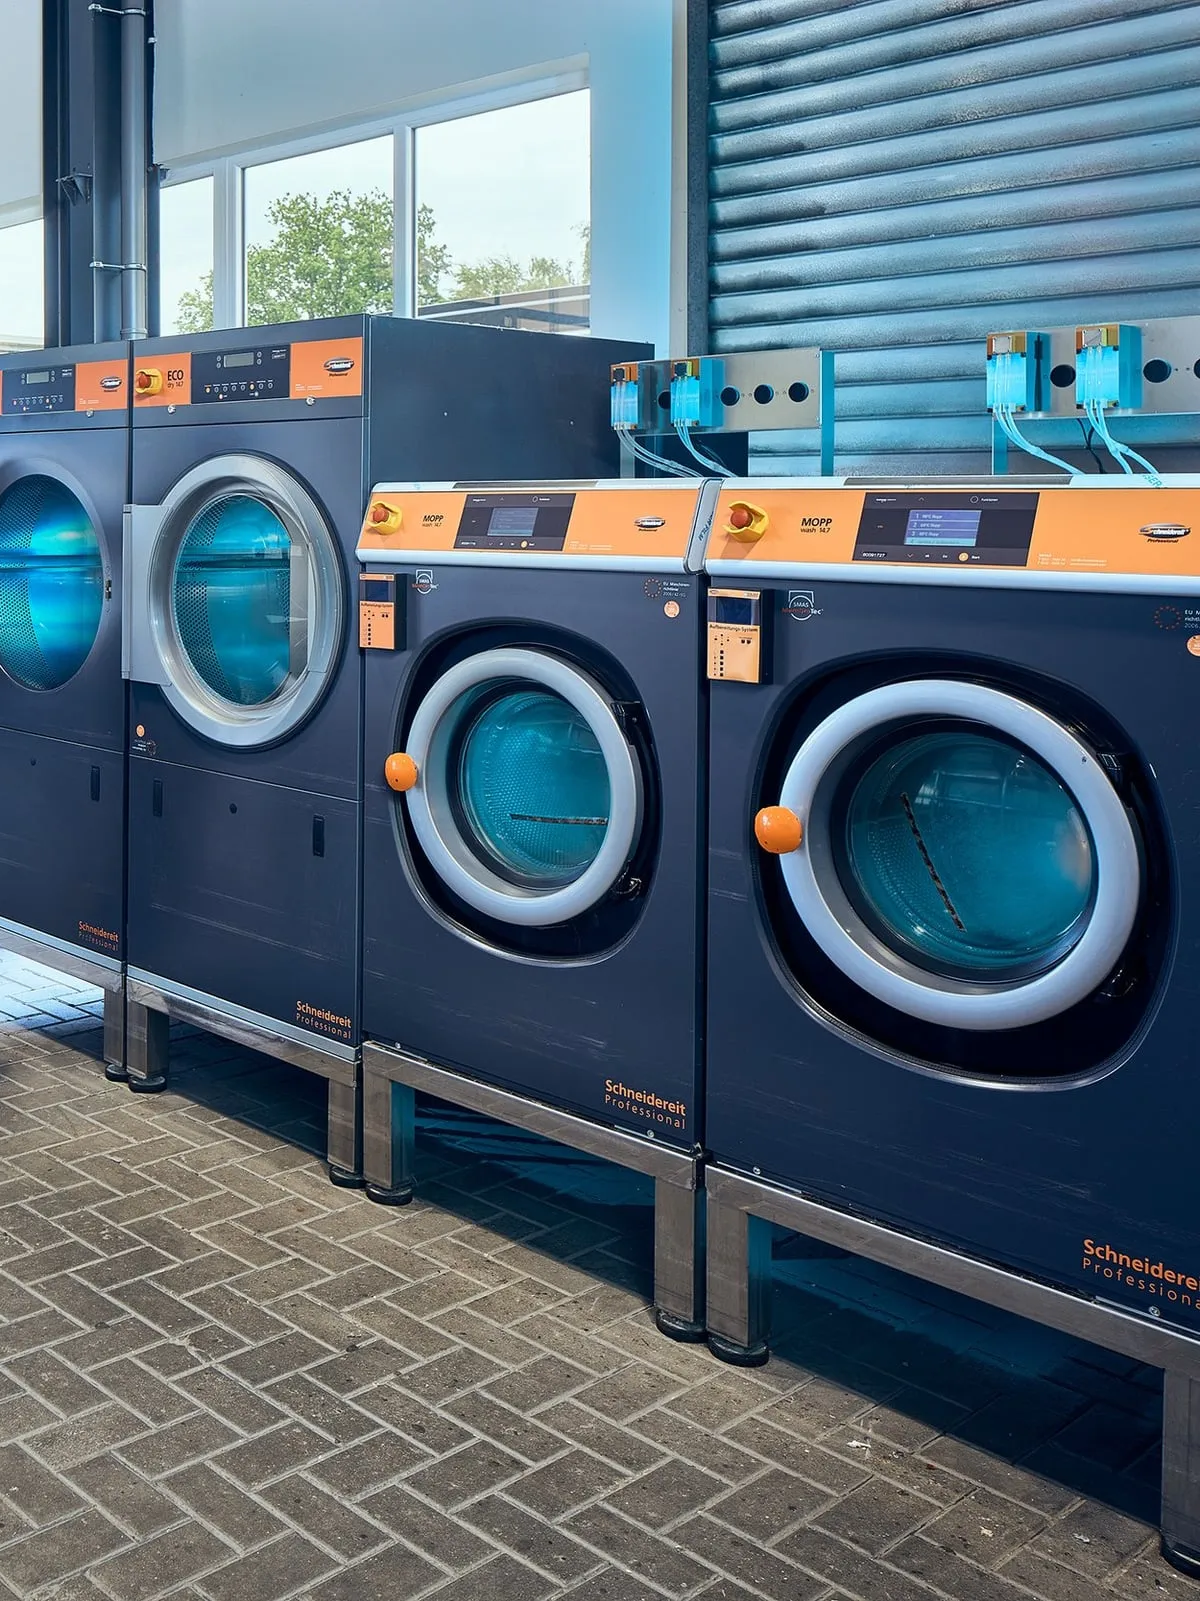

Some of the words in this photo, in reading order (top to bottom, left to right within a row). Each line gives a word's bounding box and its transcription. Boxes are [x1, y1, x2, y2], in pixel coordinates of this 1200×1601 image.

[167, 369, 184, 381] ECO
[422, 514, 444, 522] MOPP
[801, 517, 833, 527] MOPP
[78, 920, 119, 943] Schneidereit
[296, 1000, 352, 1029] Schneidereit
[296, 1012, 351, 1039] Professional
[605, 1079, 686, 1116] Schneidereit
[604, 1094, 686, 1130] Professional
